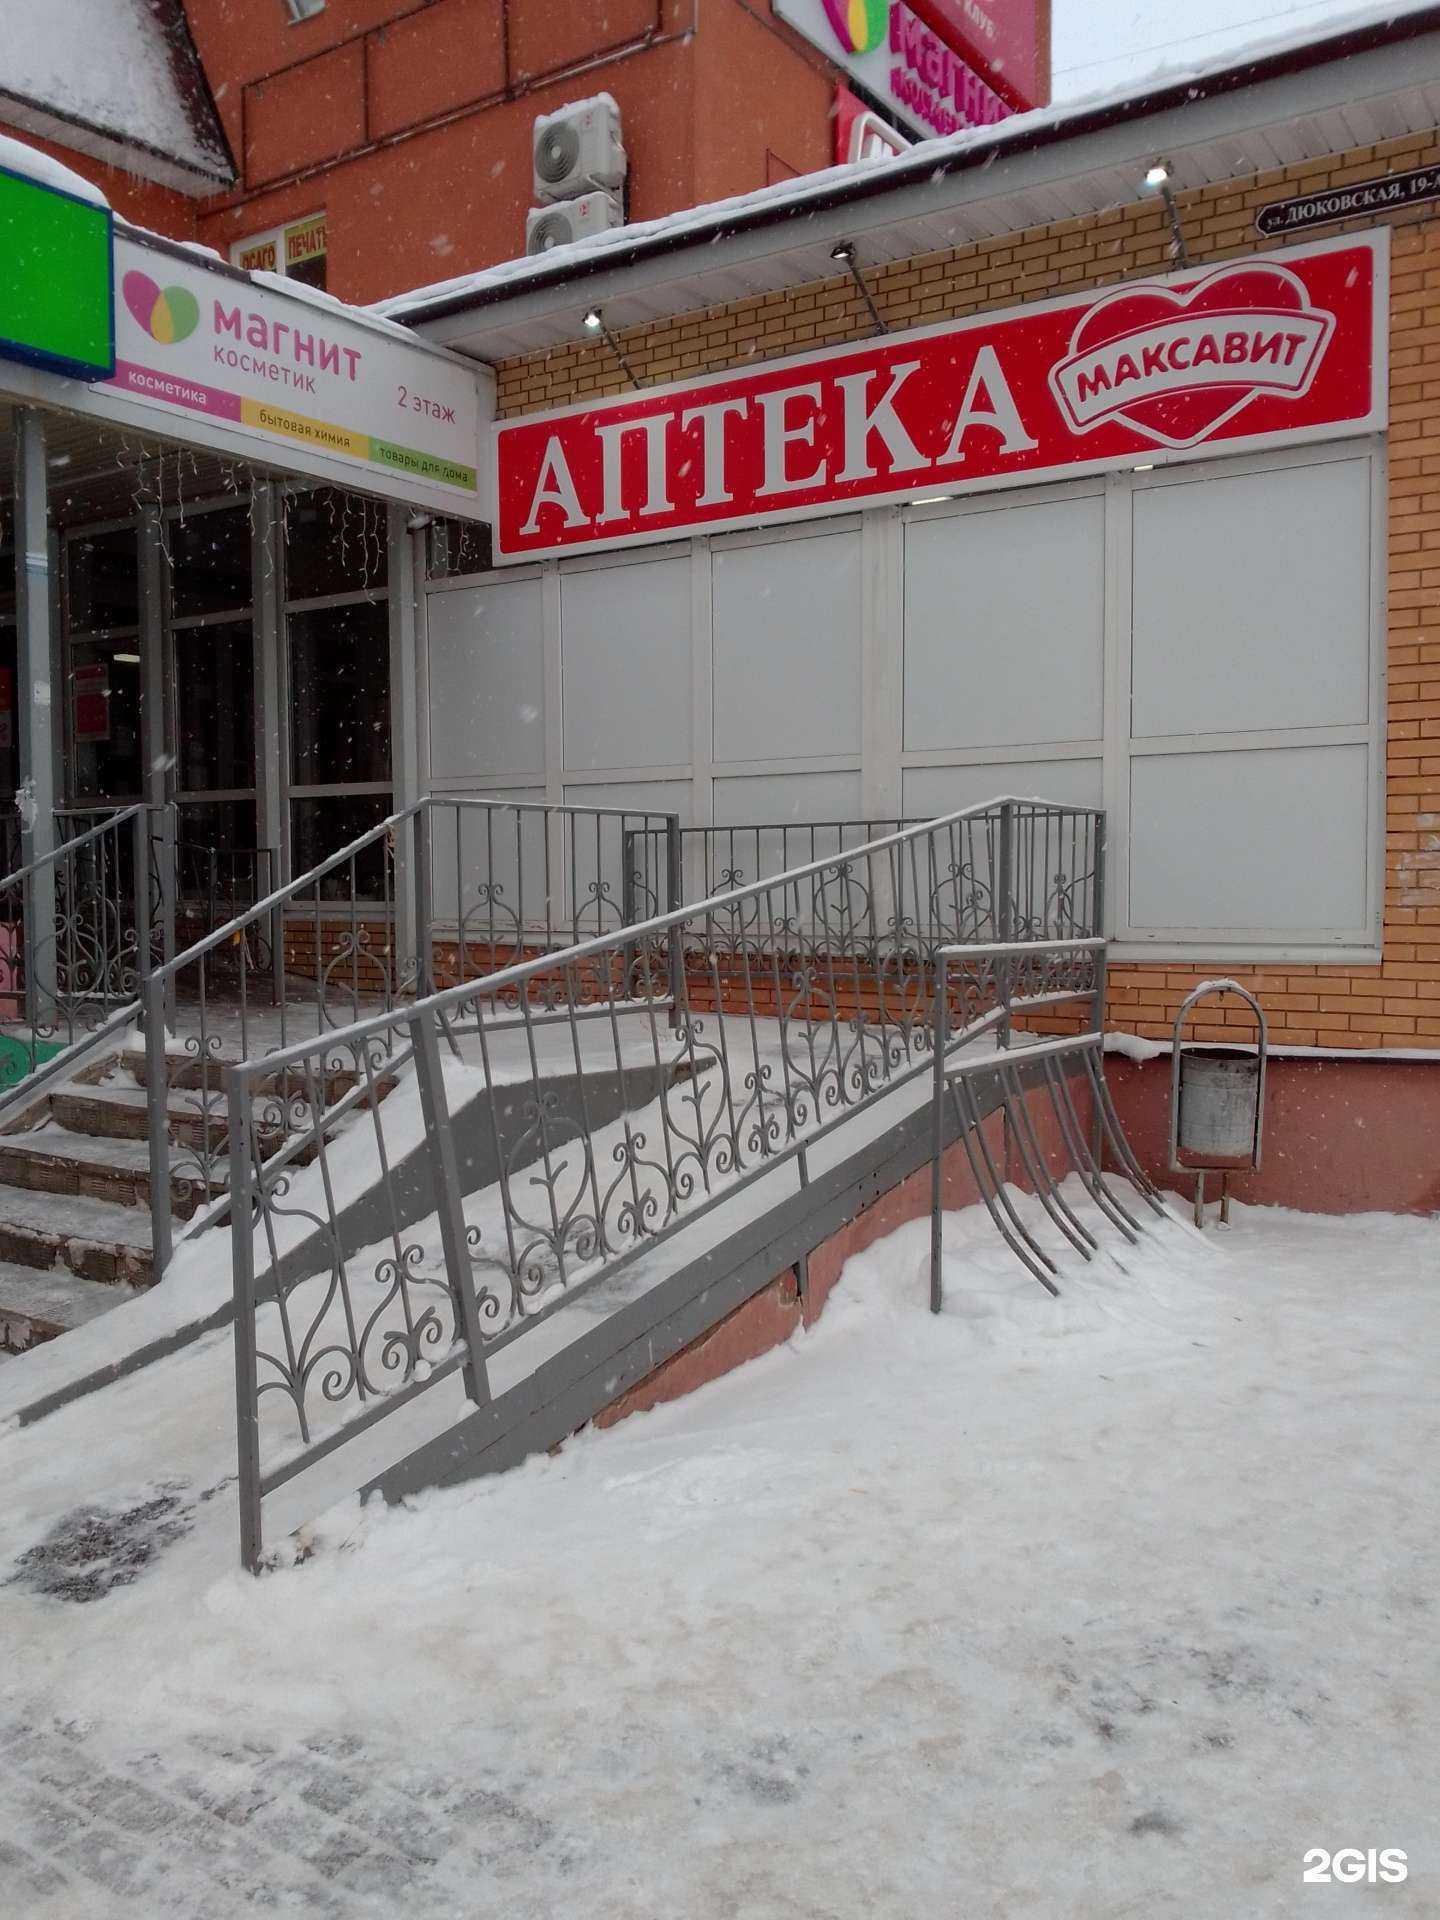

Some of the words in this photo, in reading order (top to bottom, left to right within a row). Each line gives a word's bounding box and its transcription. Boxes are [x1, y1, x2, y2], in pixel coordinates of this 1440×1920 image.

[213, 299, 363, 382] магнит
[127, 368, 208, 405] косметика
[213, 344, 318, 395] косметик
[1076, 331, 1307, 403] МАКСАВИТ
[397, 385, 408, 408] 2
[412, 396, 456, 424] этаж
[258, 408, 312, 438] бытовая
[313, 428, 351, 449] химия
[518, 344, 1040, 536] АПТЕКА
[378, 447, 419, 470] товары
[420, 459, 440, 475] для
[441, 463, 470, 483] дома
